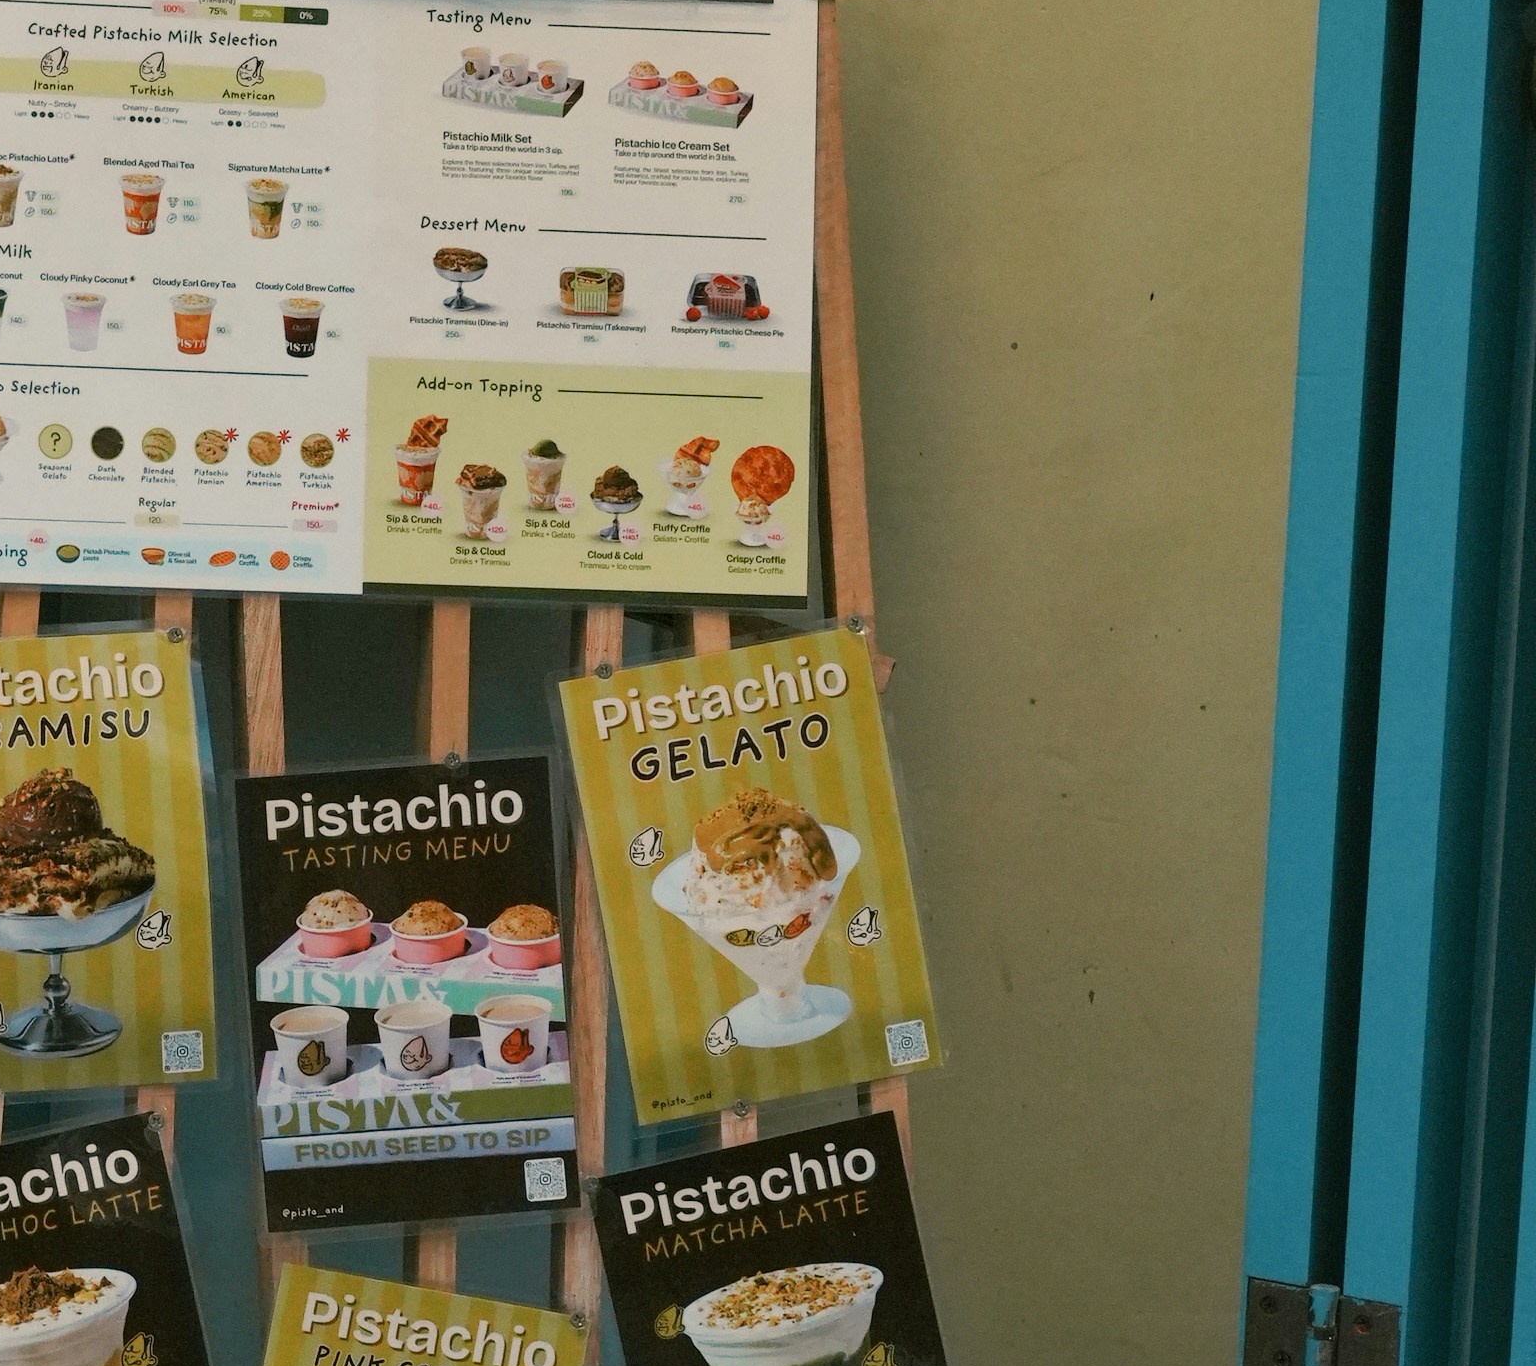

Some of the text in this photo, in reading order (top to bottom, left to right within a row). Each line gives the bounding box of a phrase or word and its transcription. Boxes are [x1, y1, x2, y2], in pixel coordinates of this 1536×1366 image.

[208, 6, 228, 16] 75%
[299, 11, 314, 21] 0%
[426, 9, 532, 32] Tasting Menu
[28, 22, 278, 47] Crafted Pistachio Milk Selection
[33, 80, 74, 91] Iranian
[130, 85, 174, 97] Turkish
[222, 89, 275, 101] American
[443, 131, 532, 143] Pistachio Milk Set
[615, 138, 730, 152] Pistachio Ice Cream Set
[9, 153, 46, 162] Pistachio
[103, 158, 137, 167] Blended
[161, 160, 178, 168] Thai
[179, 161, 195, 169] Tea
[228, 163, 268, 173] Signature
[269, 165, 299, 174] Matcha
[420, 216, 526, 233] Dessert Menu
[40, 273, 128, 284] Cloudy Pinky Coconut
[152, 278, 236, 290] Cloudy Earl Grey Tea
[255, 282, 355, 293] Cloudy Cold Brew Coffee
[11, 380, 80, 395] Selection
[416, 376, 542, 402] Add-on Topping
[138, 497, 176, 513] Regular
[386, 514, 401, 524] Sip
[410, 515, 442, 524] Crunch
[525, 519, 540, 528] Sip
[550, 519, 570, 528] Cold
[455, 546, 470, 556] Sip
[480, 547, 506, 556] Cloud
[587, 551, 613, 560] Cloud
[623, 551, 643, 561] Cold
[726, 555, 754, 565] Crispy
[592, 654, 849, 741] Pistachio
[629, 712, 831, 783] GELATO
[264, 778, 524, 841] Pistachio
[283, 833, 511, 872] TASTING MENU
[263, 1092, 462, 1135] PISTA&
[294, 1127, 551, 1162] FROM SEED TO SIP
[619, 1142, 877, 1235] Pistachio
[71, 1183, 164, 1226] LATTE
[645, 1189, 870, 1262] MATCHA LATTE
